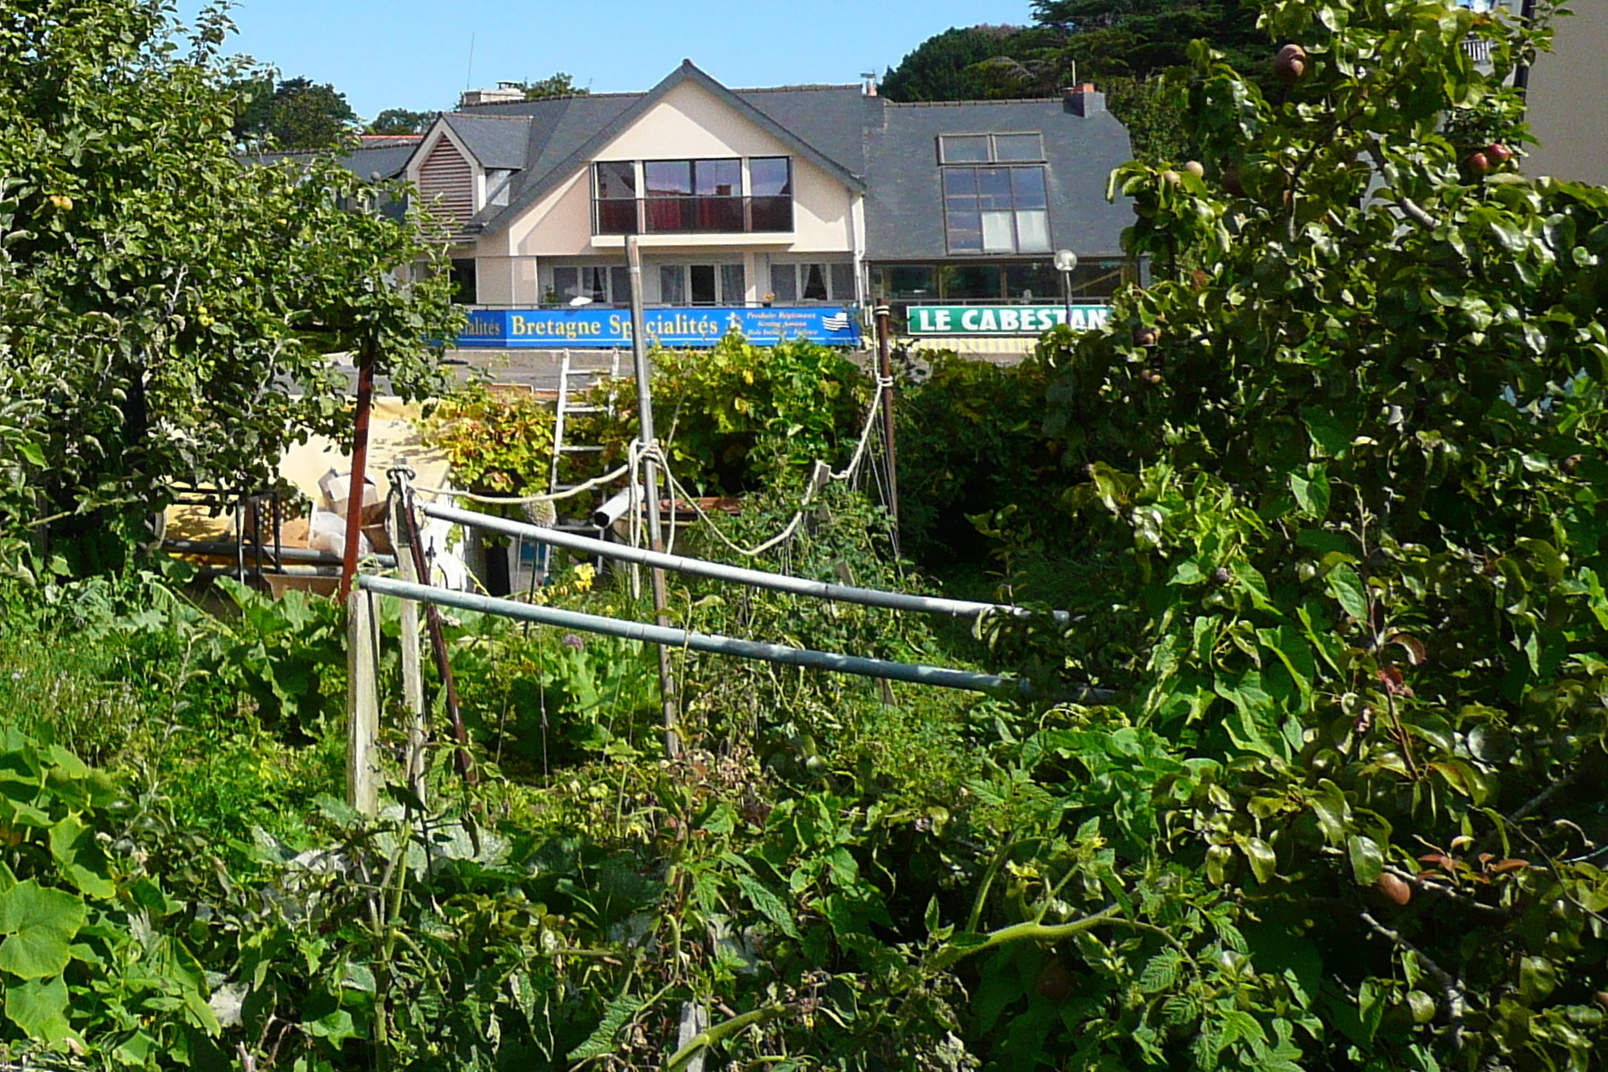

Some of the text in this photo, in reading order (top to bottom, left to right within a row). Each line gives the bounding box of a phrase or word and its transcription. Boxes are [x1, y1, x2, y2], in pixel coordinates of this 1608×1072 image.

[511, 314, 718, 339] Bretagne Spcialités
[919, 309, 1107, 330] LE CABESTAN
